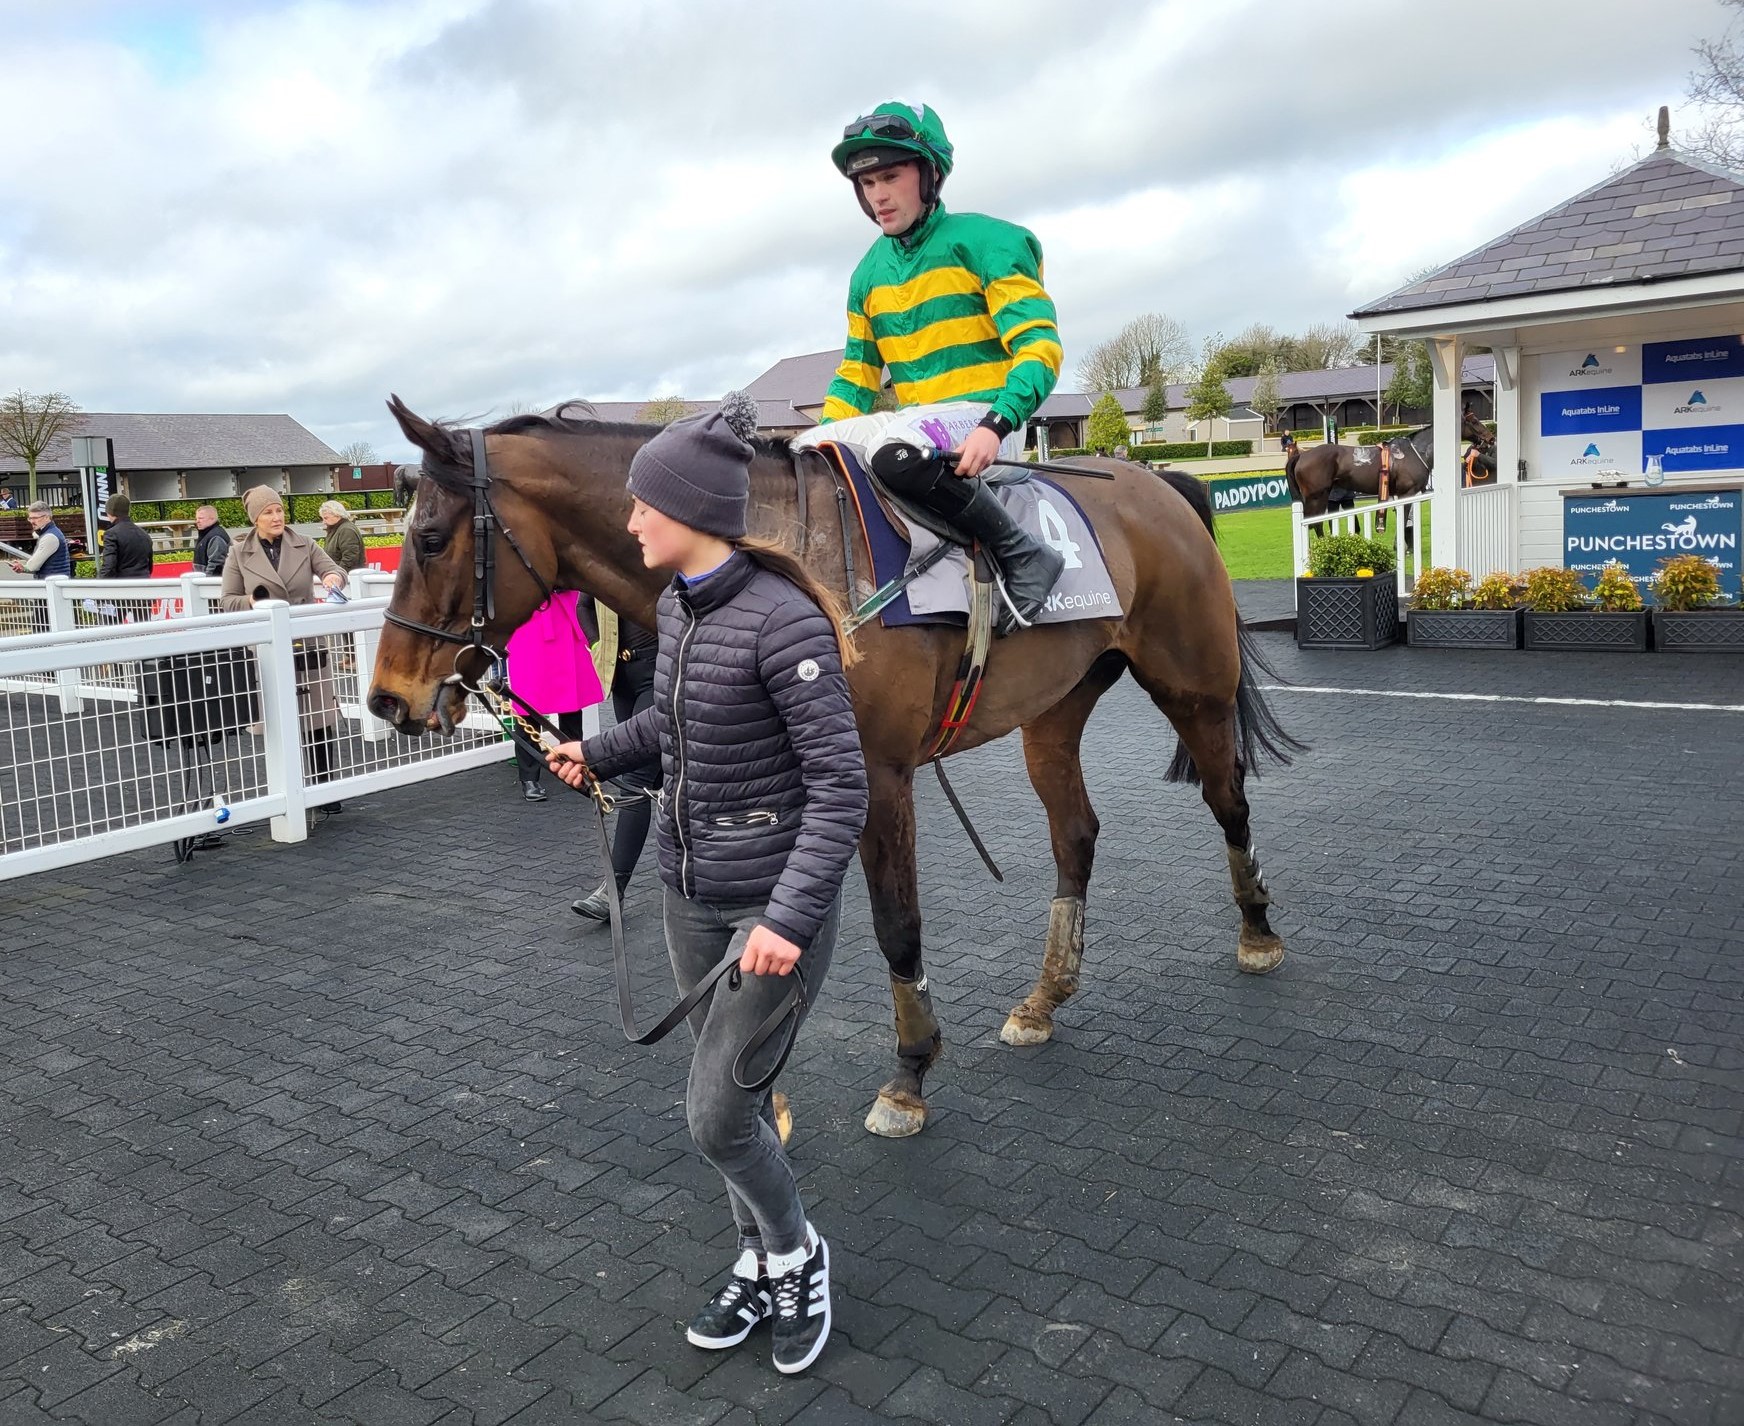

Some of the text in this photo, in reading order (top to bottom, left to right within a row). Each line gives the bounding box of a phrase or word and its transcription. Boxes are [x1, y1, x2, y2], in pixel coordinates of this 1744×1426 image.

[1665, 350, 1729, 363] Aquatabs InLine
[1569, 367, 1613, 377] ARKequine
[1561, 405, 1620, 417] Aquatabs InLine
[1665, 444, 1729, 455] Aquatabs InLine
[1570, 458, 1614, 466] ARKequine
[1570, 505, 1630, 514] PUNCHESTOWN
[1669, 502, 1734, 511] PUNCHESTOWN
[1038, 499, 1082, 569] 4
[1567, 533, 1736, 552] PUNCHESTOWN
